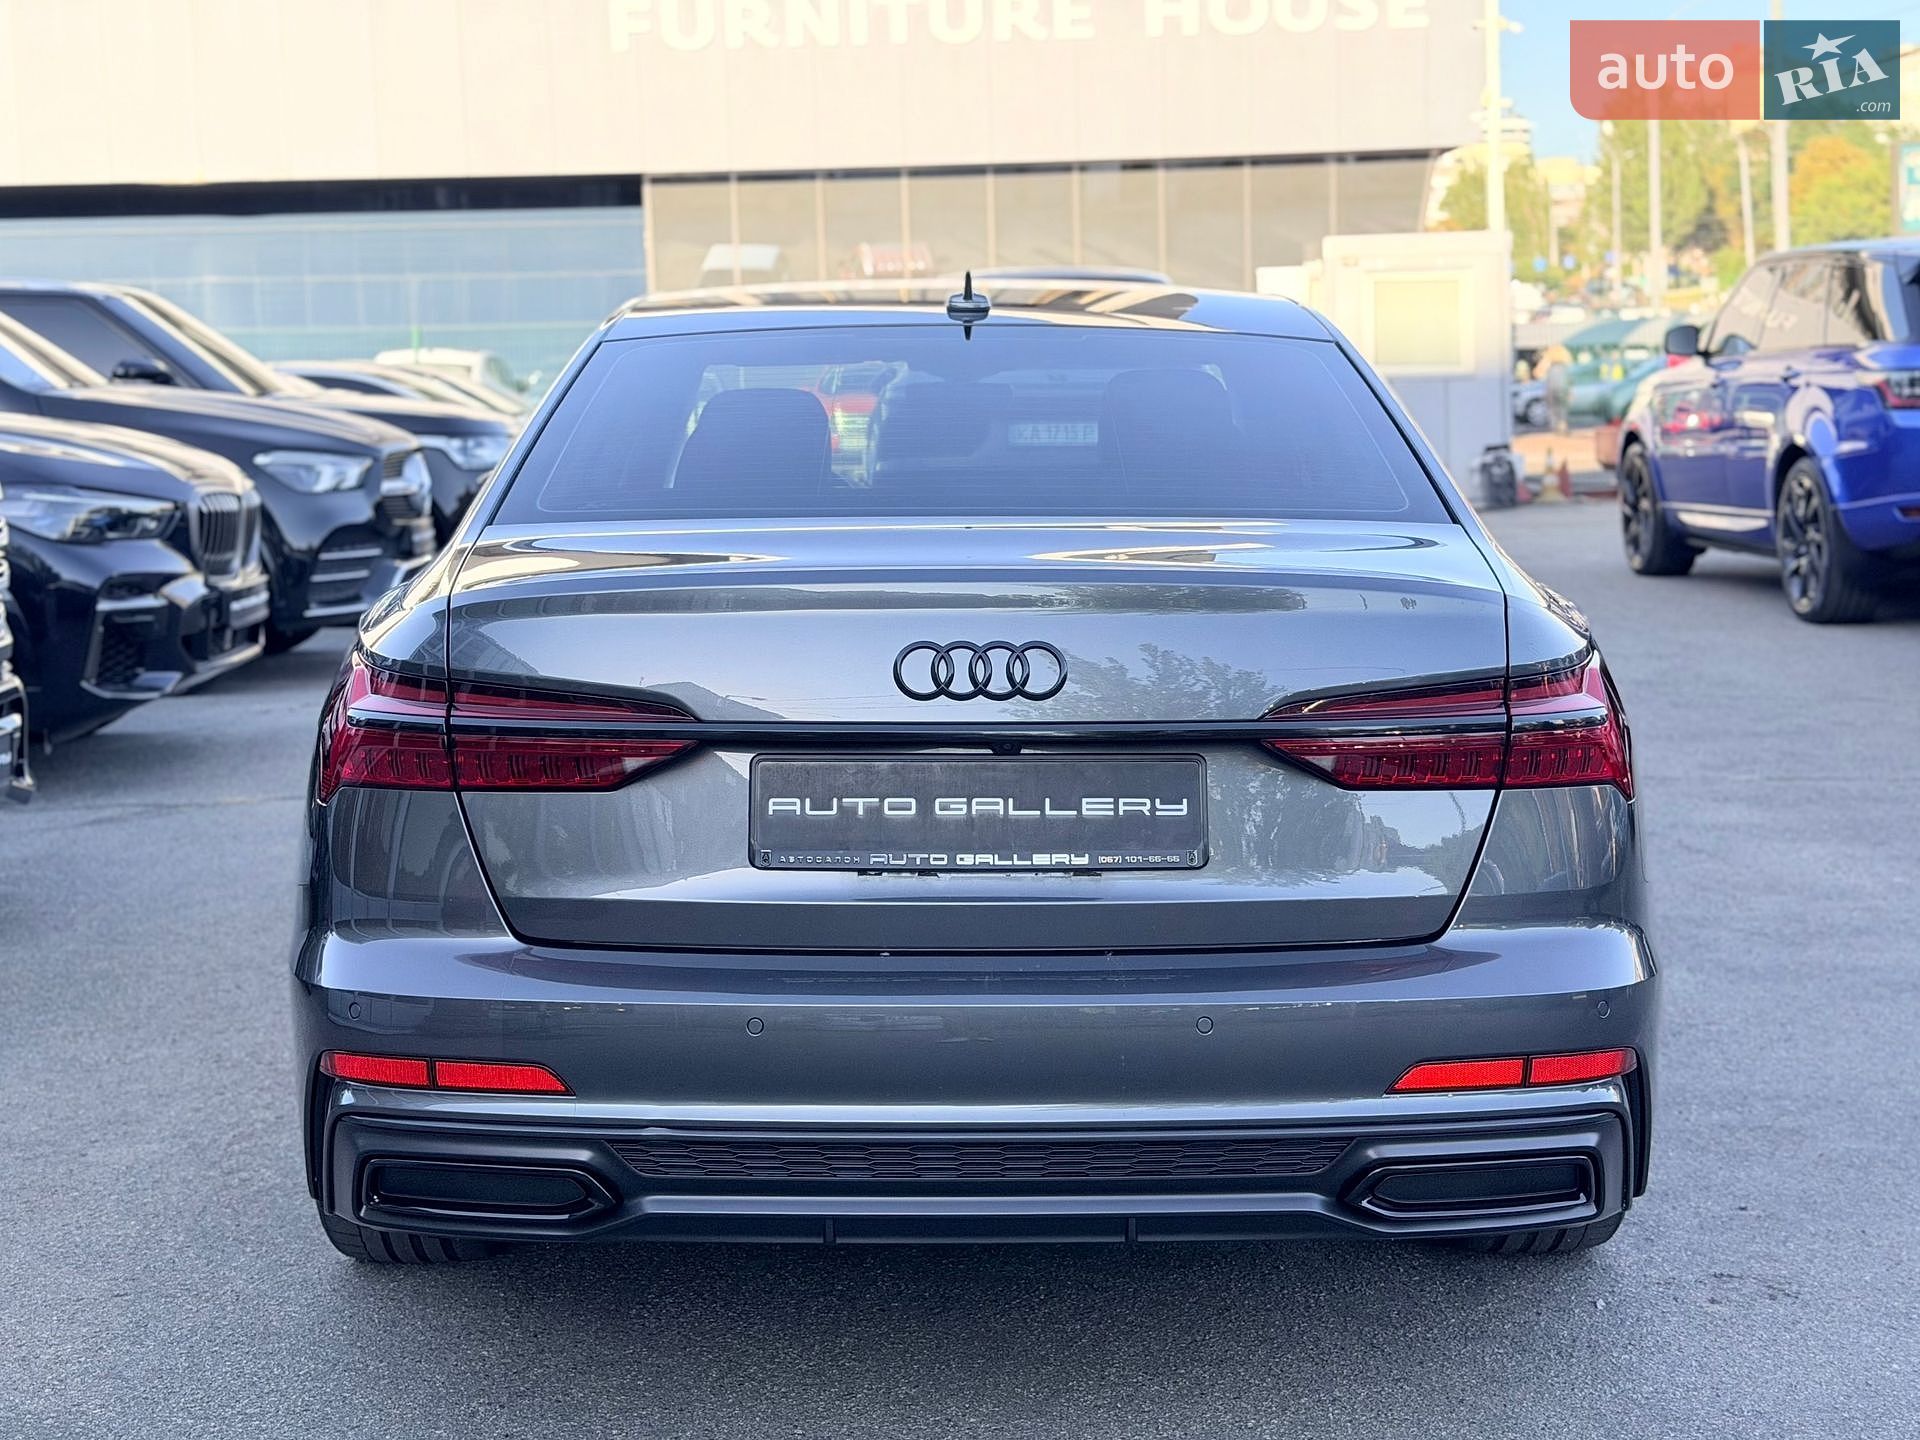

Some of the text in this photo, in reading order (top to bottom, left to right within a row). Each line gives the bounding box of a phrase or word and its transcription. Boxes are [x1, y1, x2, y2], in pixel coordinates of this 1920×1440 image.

[609, 0, 1430, 53] FURNITURE HOUSE
[768, 797, 1188, 816] AUTO GALLERY
[869, 853, 948, 865] AUTO
[955, 853, 1090, 865] GALLERY
[1098, 855, 1122, 864] (067)
